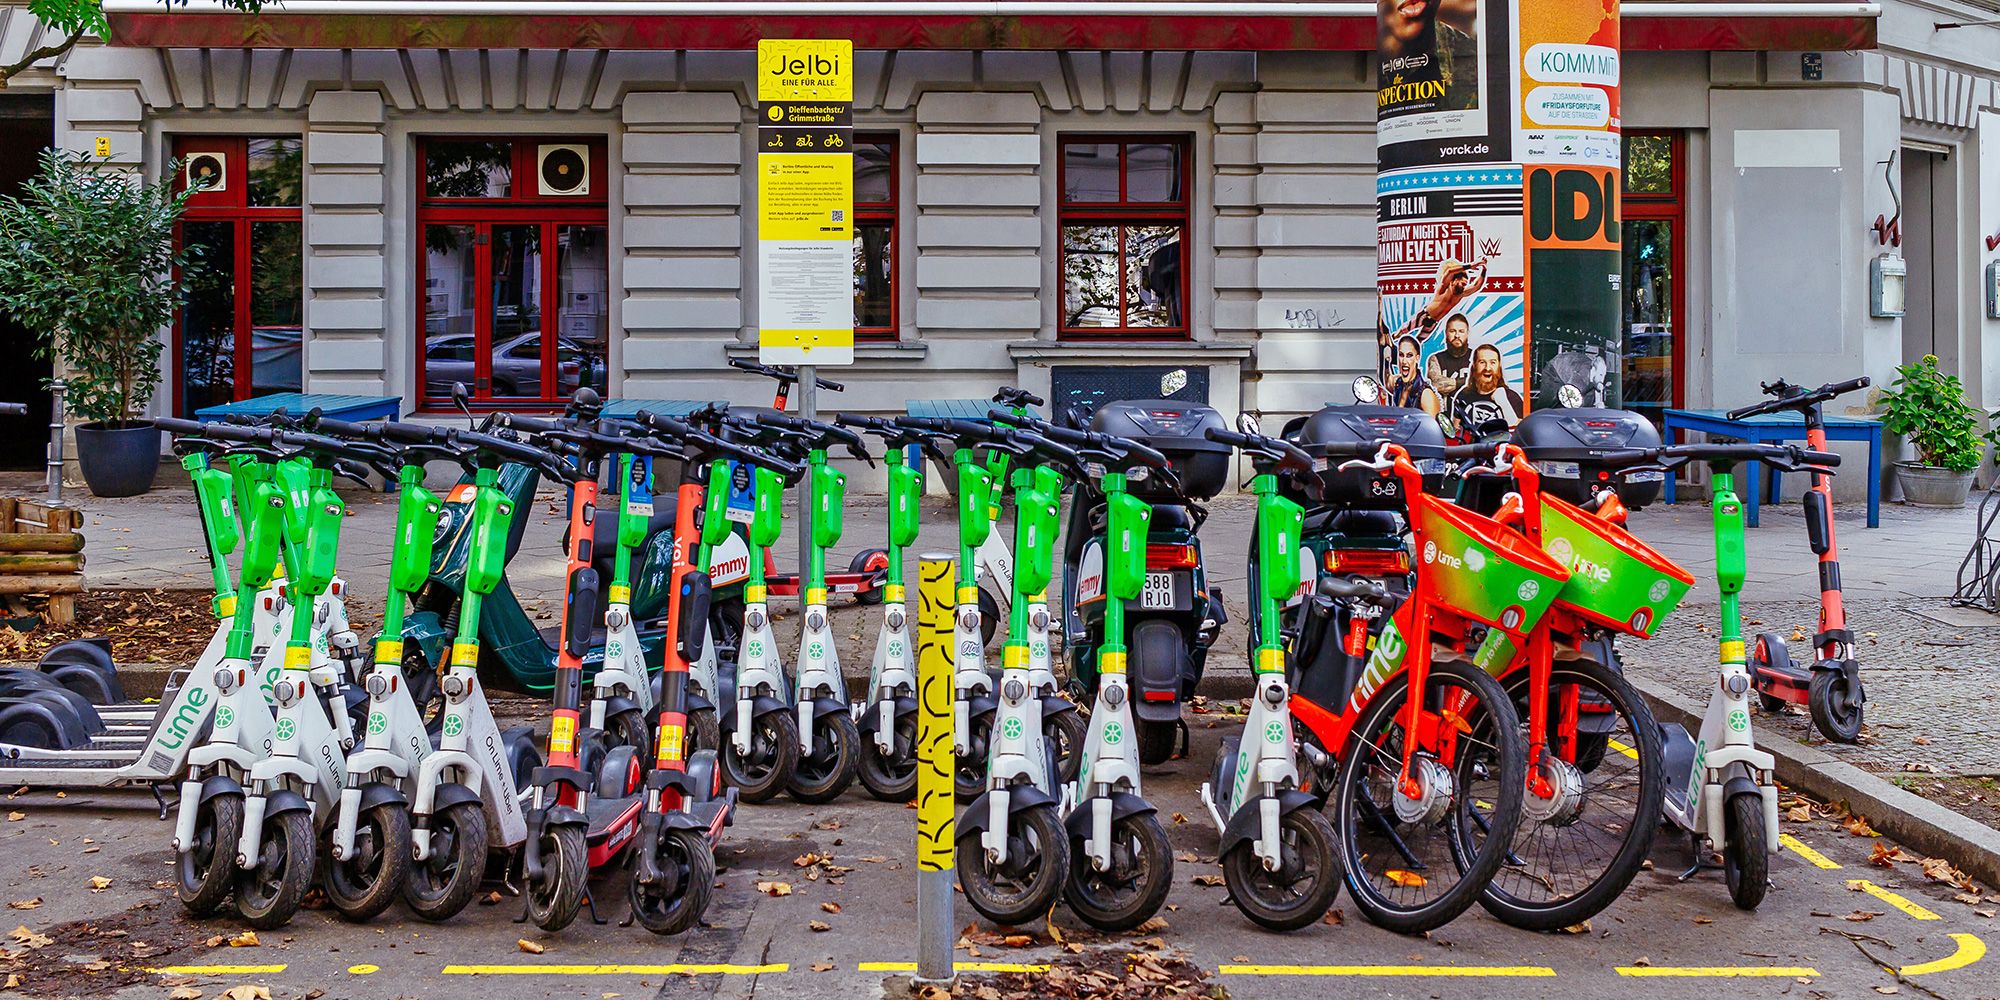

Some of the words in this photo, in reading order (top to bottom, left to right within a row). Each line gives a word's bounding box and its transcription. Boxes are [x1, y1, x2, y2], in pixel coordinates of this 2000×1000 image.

[771, 54, 839, 76] Jelbi
[1541, 52, 1594, 74] KOMM
[801, 77, 816, 86] FÜR
[1542, 101, 1601, 111] #FRIDAYSFORFUTURE
[1552, 92, 1585, 101] ZUSAMMEN
[1586, 93, 1594, 101] MIT
[788, 114, 835, 123] Grimmstraße
[1548, 111, 1560, 119] AUF
[1561, 111, 1570, 119] DIE
[1439, 143, 1489, 158] yorck.de
[1390, 196, 1427, 217] BERLIN
[1381, 225, 1411, 242] SATURDAY
[1413, 223, 1449, 240] NIGHT'S
[1379, 241, 1403, 264] MAIN
[1406, 239, 1459, 262] EVENT
[709, 555, 748, 579] emmy
[997, 559, 1006, 571] On
[1437, 550, 1462, 570] Lime
[1144, 575, 1170, 590] 588
[157, 687, 209, 750] Lime
[410, 736, 420, 757] On
[321, 745, 332, 764] On
[328, 760, 342, 790] Lime
[485, 736, 496, 754] On
[492, 750, 504, 781] Lime
[503, 787, 513, 815] Uber
[1689, 740, 1707, 807] Lime
